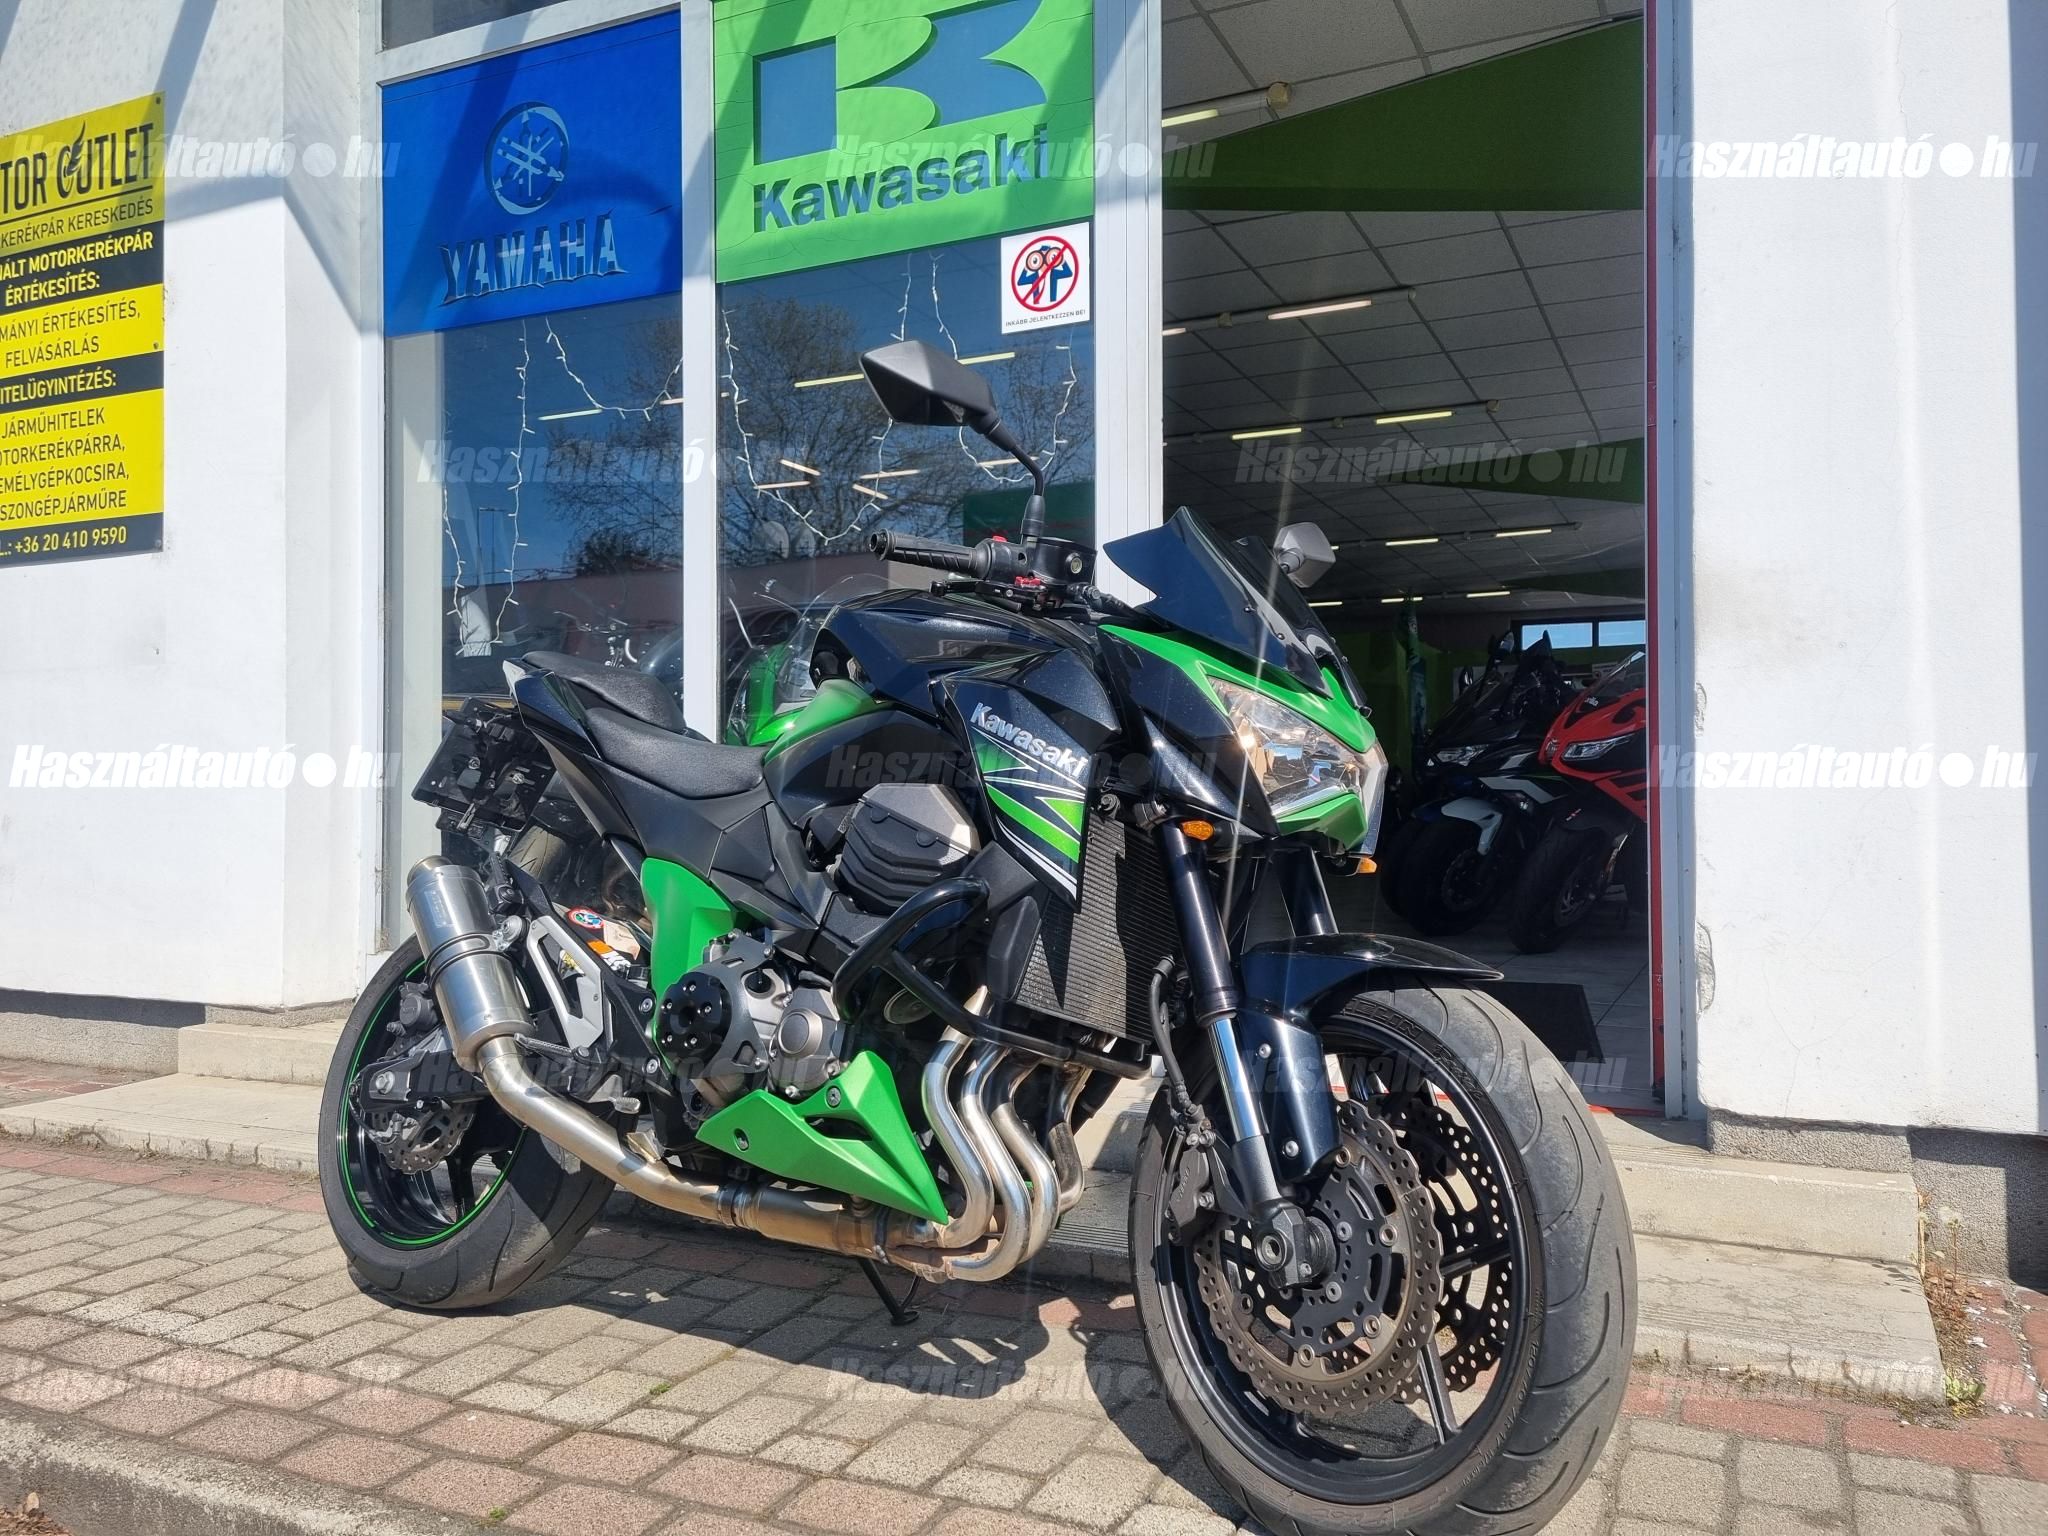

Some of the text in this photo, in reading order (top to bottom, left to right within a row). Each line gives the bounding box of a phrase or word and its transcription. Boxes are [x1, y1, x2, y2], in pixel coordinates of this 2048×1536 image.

[0, 122, 154, 214] TOR OUTLET
[753, 122, 1049, 234] Kawasaki
[1, 195, 153, 249] KERÉKPÁR KERESKEDÉS
[28, 229, 153, 273] MOTORKERÉKPÁR
[440, 212, 626, 303] YAMAHA
[5, 268, 100, 307] ÉRTÉKESÍTÉS:
[42, 296, 141, 334] ÉRTÉKESÍTÉS,
[5, 332, 100, 369] FELVÁSÁRLÁS
[1, 406, 105, 439] JÁRMŰHITELEK
[15, 535, 39, 554] +36
[43, 533, 59, 552] 20
[62, 529, 88, 549] 410
[92, 525, 127, 546] 9590
[970, 702, 1088, 779] Kawasaki
